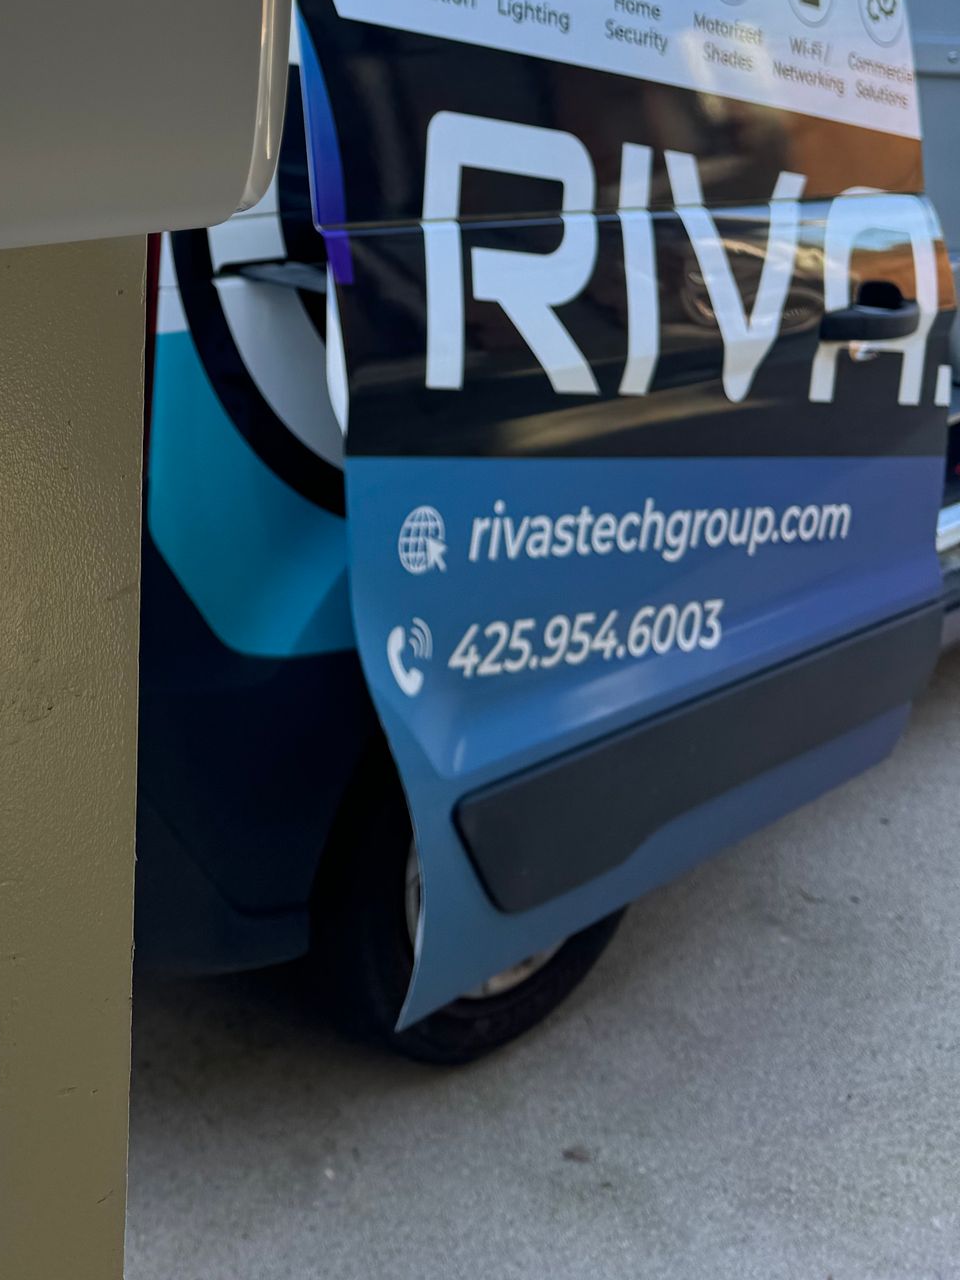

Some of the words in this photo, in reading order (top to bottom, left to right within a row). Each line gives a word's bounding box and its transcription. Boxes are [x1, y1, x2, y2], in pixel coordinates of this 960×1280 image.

[605, 18, 668, 56] Security
[693, 11, 763, 45] Motorized
[703, 41, 754, 71] Shades
[847, 51, 915, 85] Commercia
[773, 61, 846, 97] Networking
[855, 78, 911, 110] Solutions
[420, 109, 951, 407] RIVA
[468, 498, 852, 563] rivastechgroup.com
[448, 598, 725, 679] 425.954.6003
